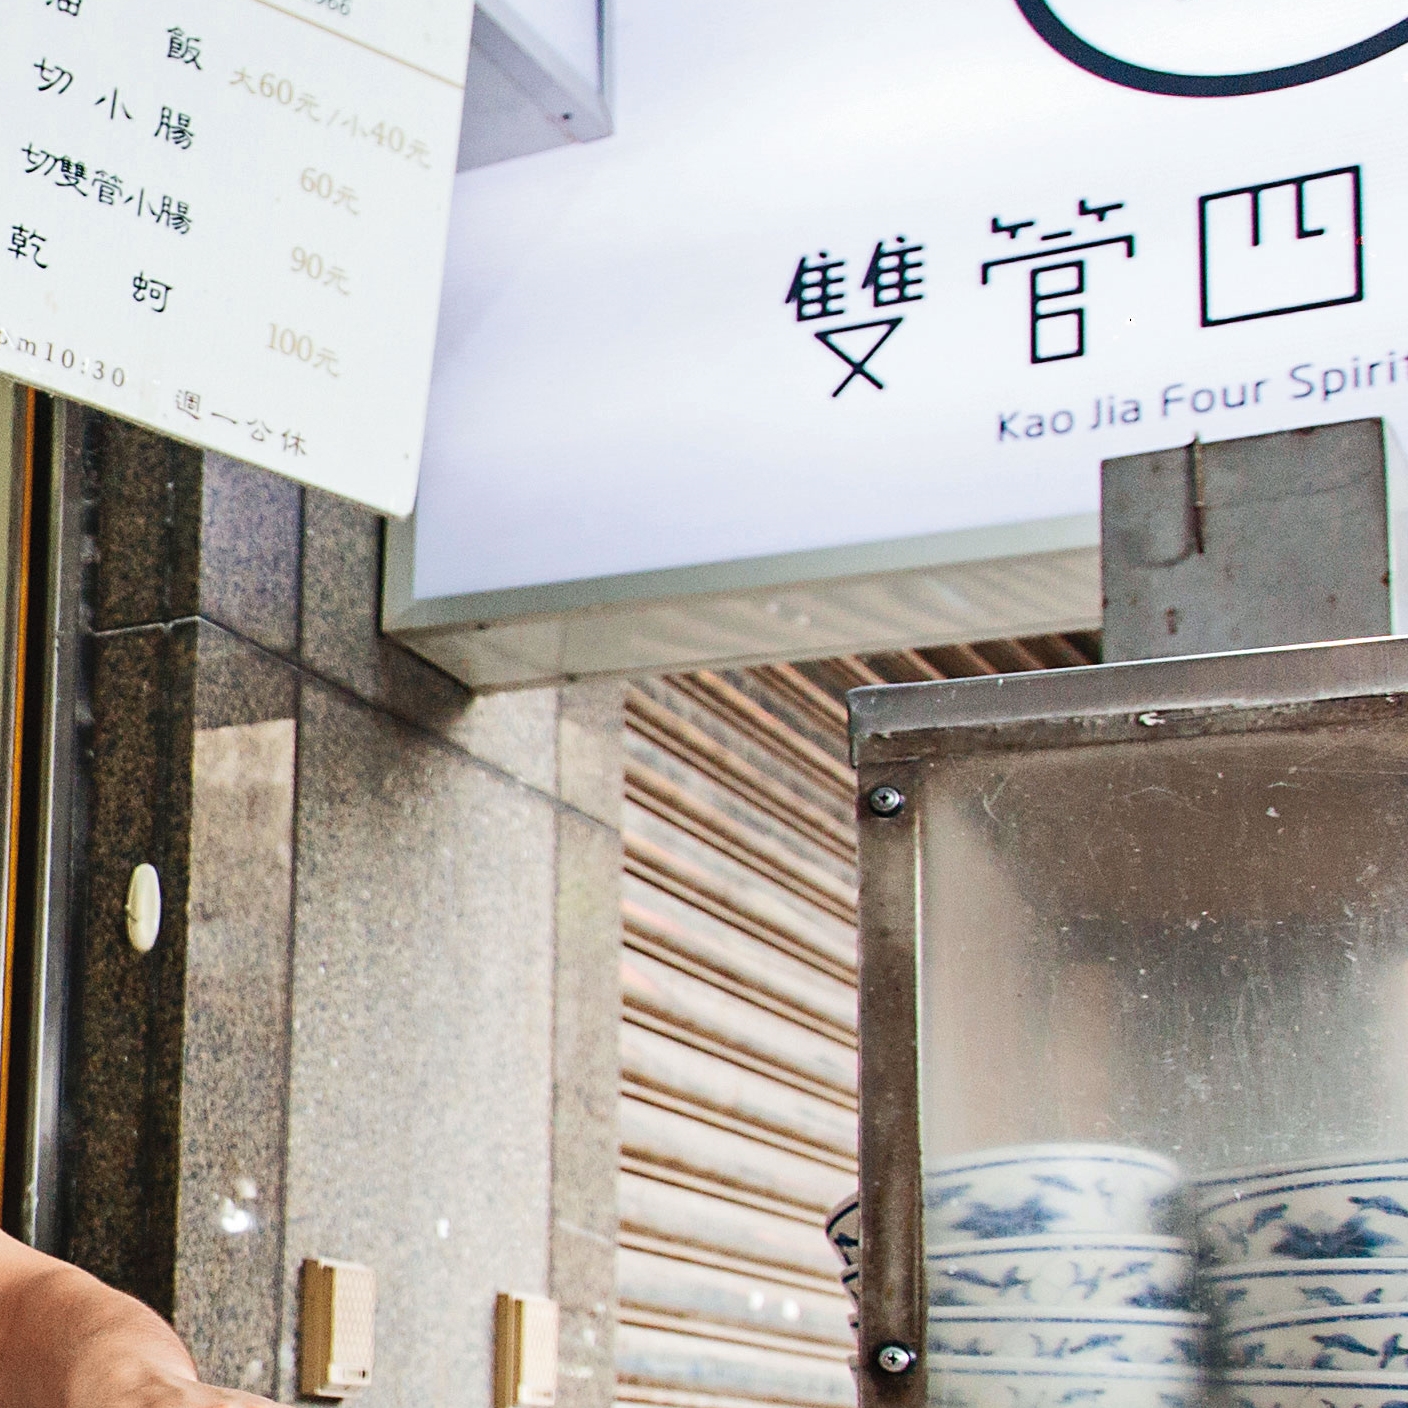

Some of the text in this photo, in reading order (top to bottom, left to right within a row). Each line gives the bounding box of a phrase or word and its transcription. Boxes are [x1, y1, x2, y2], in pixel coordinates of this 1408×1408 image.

[21, 142, 350, 296] 切雙管小腸 90元
[300, 167, 360, 217] 60元
[785, 164, 1364, 398] 雙管四
[267, 322, 340, 378] 100元
[175, 389, 308, 457] 週一公休
[997, 409, 1075, 441] Kao
[1089, 395, 1141, 430] Jia
[1161, 378, 1270, 417] Four
